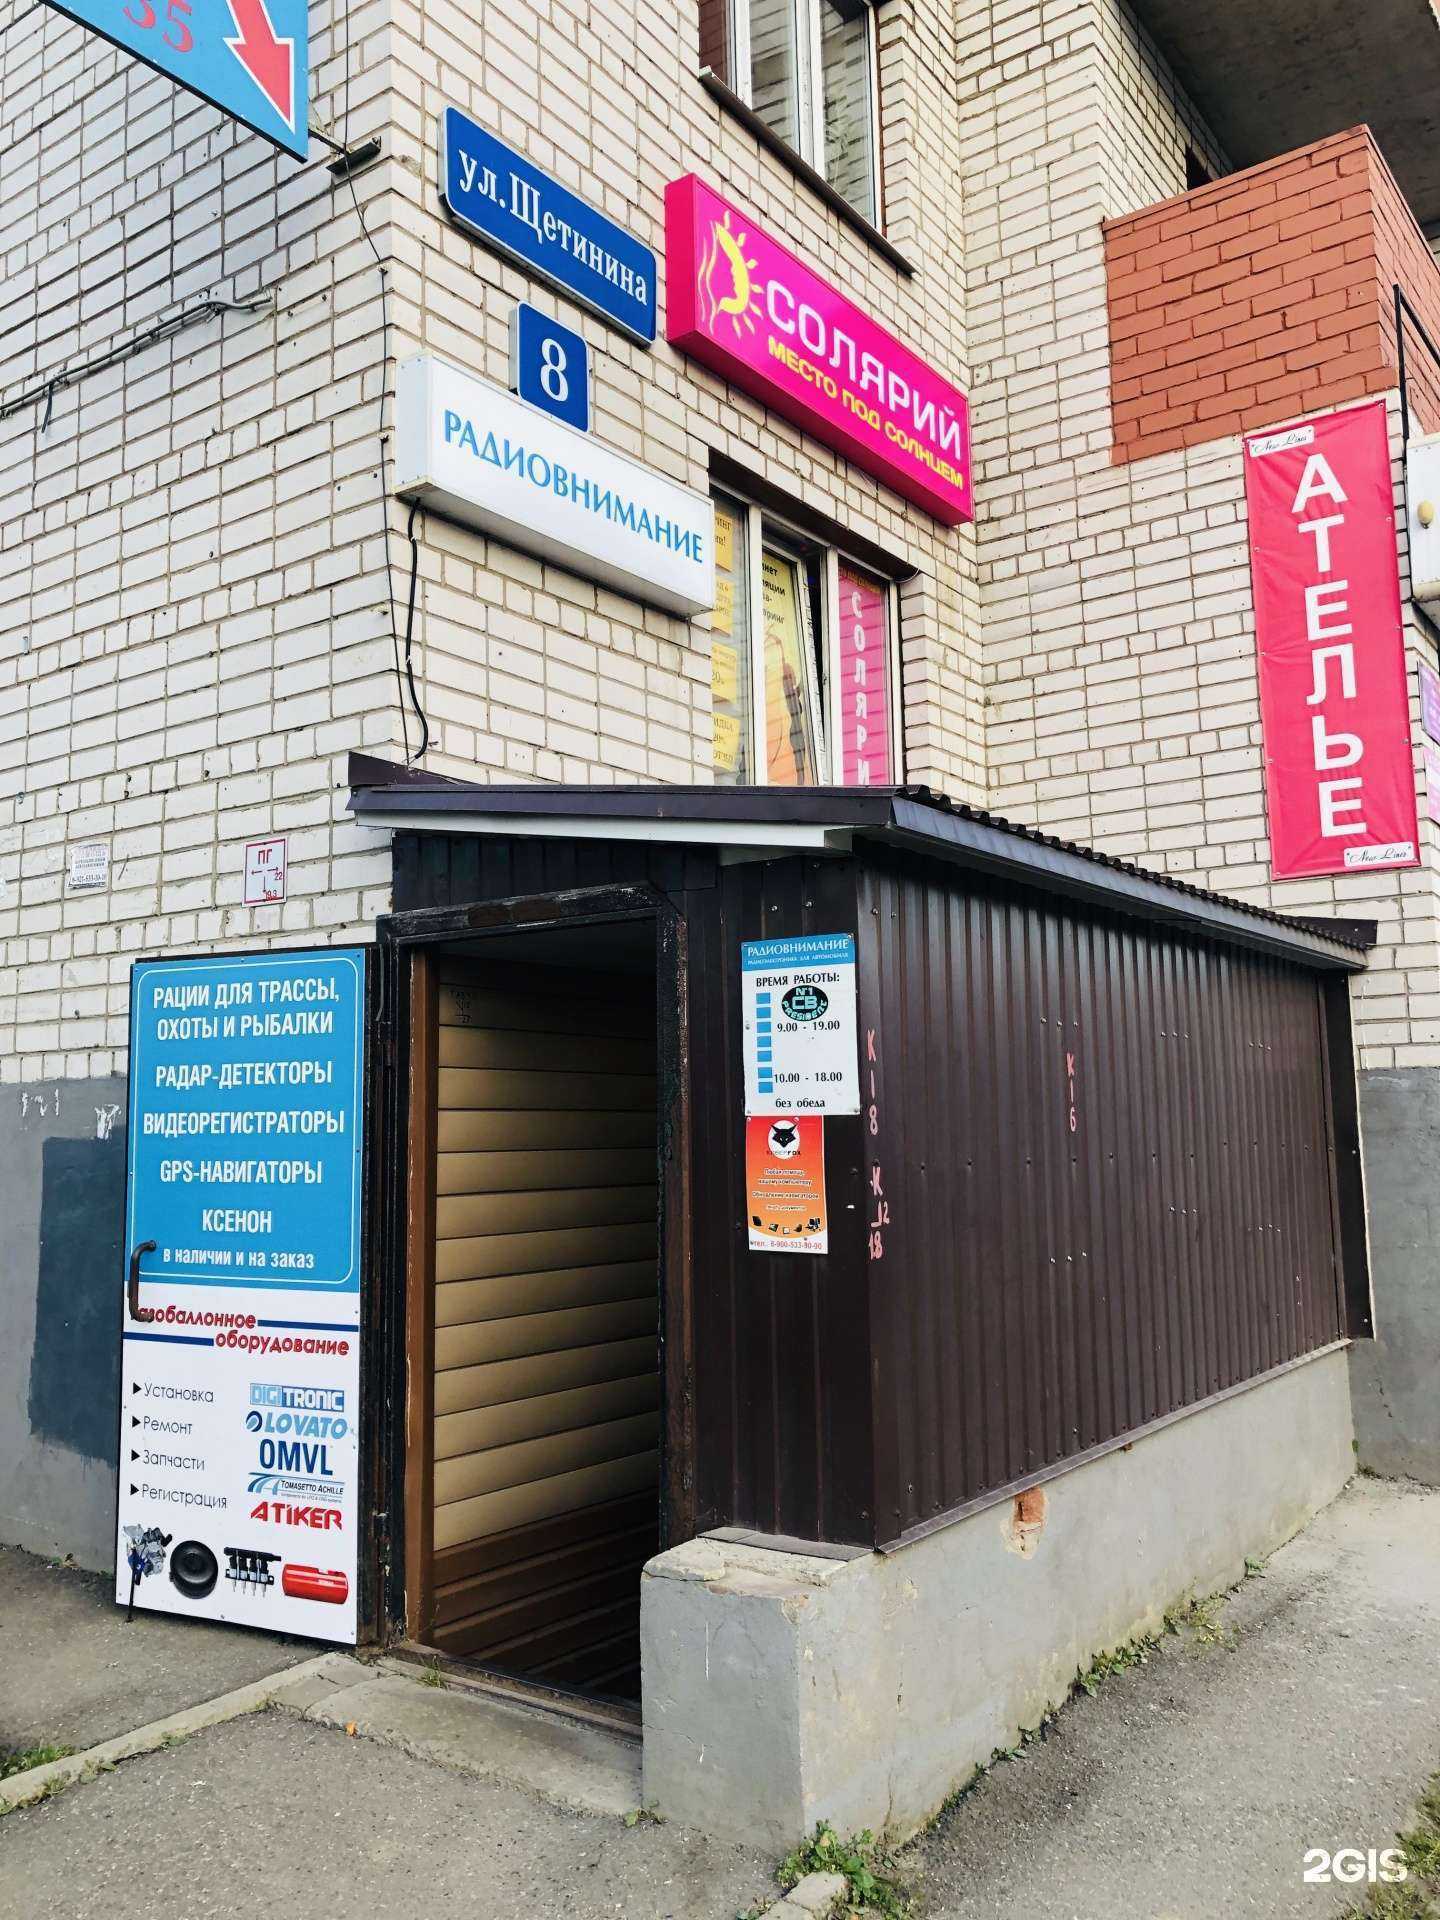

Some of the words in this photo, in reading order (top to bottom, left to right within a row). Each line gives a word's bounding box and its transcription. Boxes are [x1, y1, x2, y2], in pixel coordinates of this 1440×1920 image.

[540, 336, 569, 402] 8
[767, 280, 961, 460] СОЛЯРИЙ
[768, 335, 838, 398] МЕСТО
[842, 389, 880, 431] ПОД
[884, 421, 963, 490] СОЛНЦЕМ
[444, 409, 703, 563] РАДИОВНИМАНИЕ
[1291, 453, 1367, 837] АТЕЛЬЕ
[258, 849, 272, 864] ПГ
[747, 939, 849, 957] РАДИОВНИМАНИЕ
[756, 975, 788, 987] ВРЕМЯ
[794, 972, 840, 984] РАБОТЫ:
[153, 985, 209, 1010] РАЦИИ
[215, 982, 252, 1009] ДЛЯ
[258, 977, 339, 1003] ТРАССЫ,
[157, 1016, 217, 1040] ОХОТЫ
[224, 1015, 235, 1037] И
[240, 1011, 333, 1037] РЫБАЛКИ
[777, 1021, 798, 1032] 9.00
[813, 1020, 840, 1031] 19.00
[156, 1060, 333, 1090] РАДАР-ДЕТЕКТОРЫ
[774, 1073, 800, 1083] 10.00
[815, 1072, 842, 1082] 18.00
[775, 1099, 792, 1108] без
[797, 1098, 825, 1108] обеда
[143, 1110, 344, 1138] ВИДЕОРЕГИСТРАТОРЫ
[160, 1160, 322, 1184] GPS-НАВИГАТОРЫ
[203, 1209, 272, 1233] КСЕНОН
[164, 1248, 170, 1263] в
[175, 1249, 231, 1266] наличии
[236, 1251, 244, 1266] и
[249, 1251, 265, 1267] на
[271, 1253, 314, 1269] заказ
[215, 1330, 350, 1356] оборудование
[144, 1382, 214, 1404] Установка
[143, 1416, 193, 1435] Ремонт
[265, 1413, 349, 1440] LOVATO
[142, 1449, 205, 1471] Запчасти
[259, 1438, 333, 1476] OMVL
[141, 1483, 228, 1509] Регистрация
